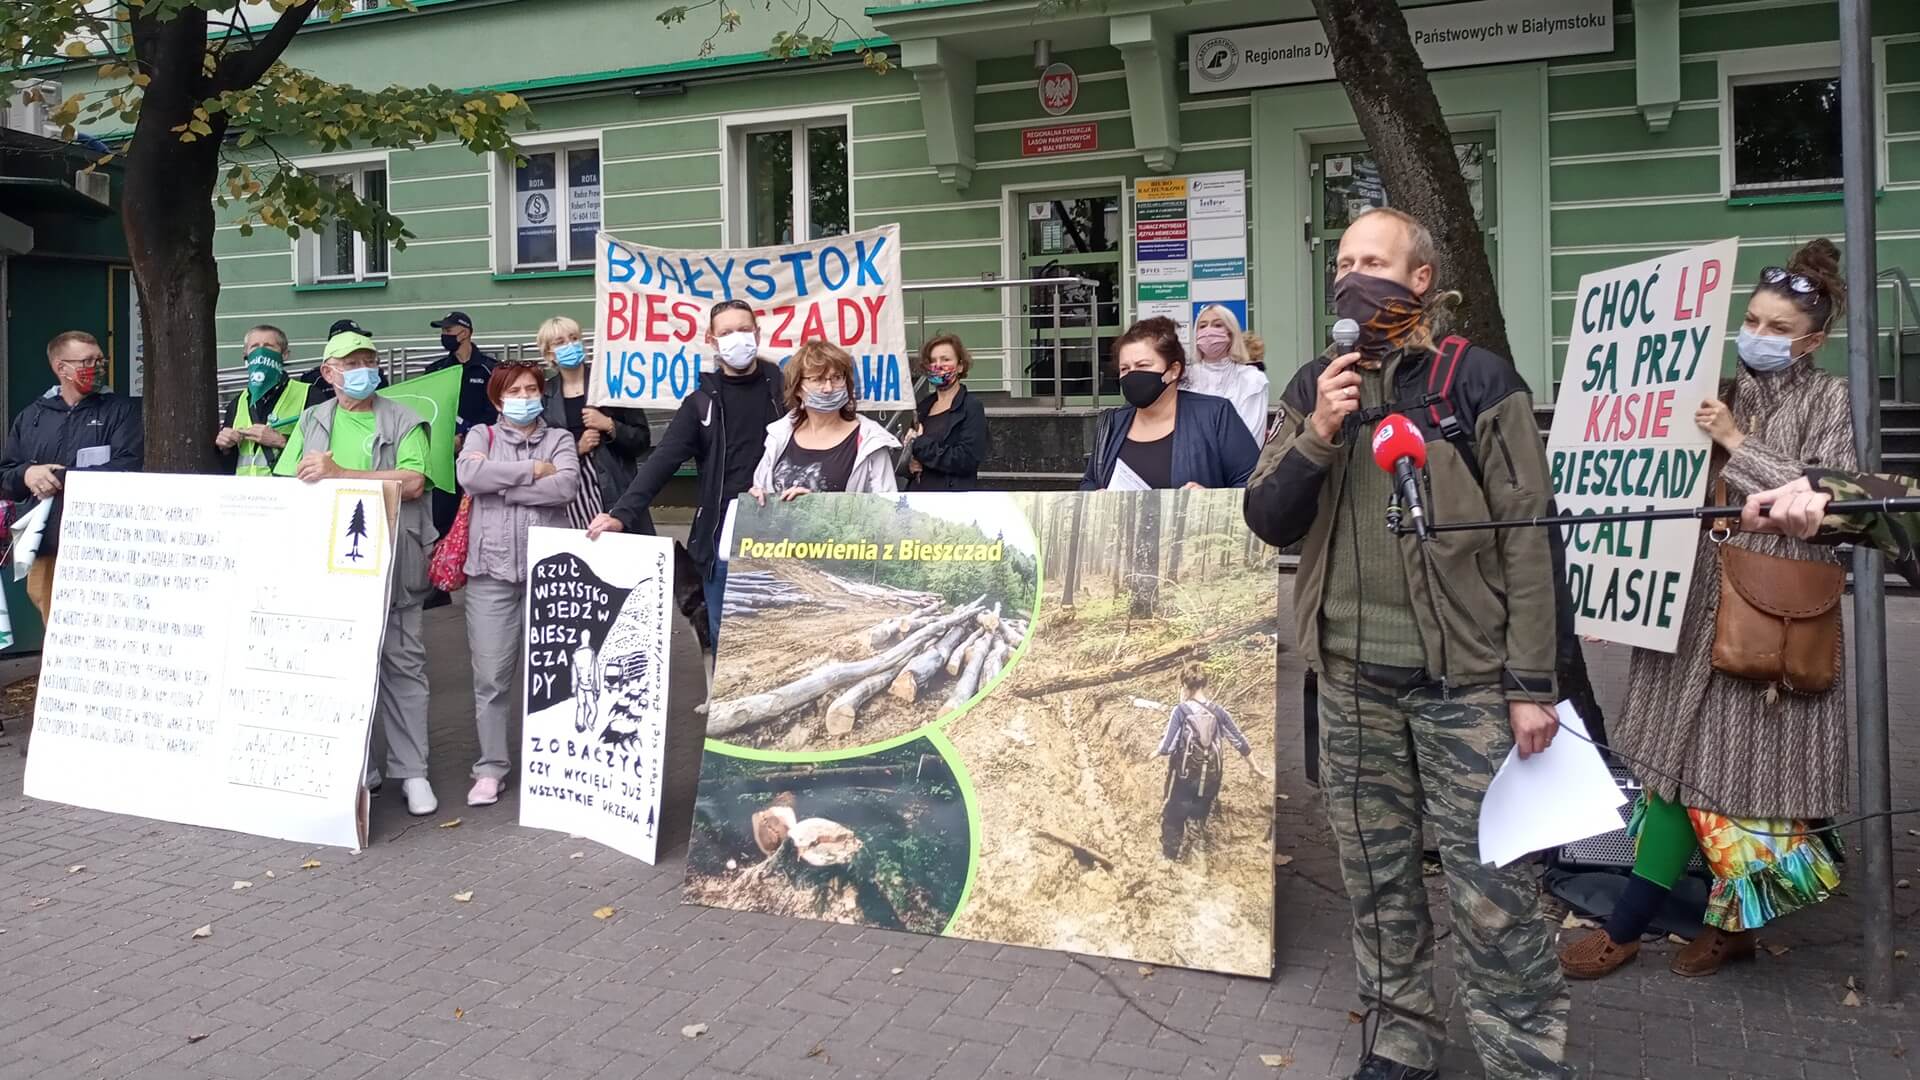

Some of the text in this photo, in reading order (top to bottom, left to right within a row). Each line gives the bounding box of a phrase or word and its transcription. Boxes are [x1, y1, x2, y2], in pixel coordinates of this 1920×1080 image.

[1245, 13, 1606, 65] Regionalna Dy Państwowych w Białymstoku
[1026, 129, 1062, 138] REGIONALNA
[581, 174, 597, 183] ROTA
[607, 236, 888, 301] BIAŁYSTOK
[1581, 259, 1721, 334] CHOĆ LP
[606, 293, 887, 348] BIESZADY
[1581, 325, 1711, 394] SĄ PRZY
[1584, 389, 1676, 443] KASIE
[1551, 448, 1706, 499] BIESZCZADY
[537, 558, 580, 578] RZUĆ
[739, 538, 1001, 561] Pozdrowienia z Bieszczad
[534, 607, 540, 620] I
[546, 601, 592, 620] JEDŹ
[535, 581, 609, 605] WSZYSTKO
[1567, 563, 1681, 628] DLASIE
[530, 624, 578, 645] BIESZ
[530, 649, 569, 667] CZA
[533, 672, 557, 700] DY
[531, 737, 642, 779] ZOBACZYĆ
[529, 761, 641, 801] CZY WYCIĘLI JUŻ
[529, 785, 640, 825] WSZYSTKIE DRZEWA
